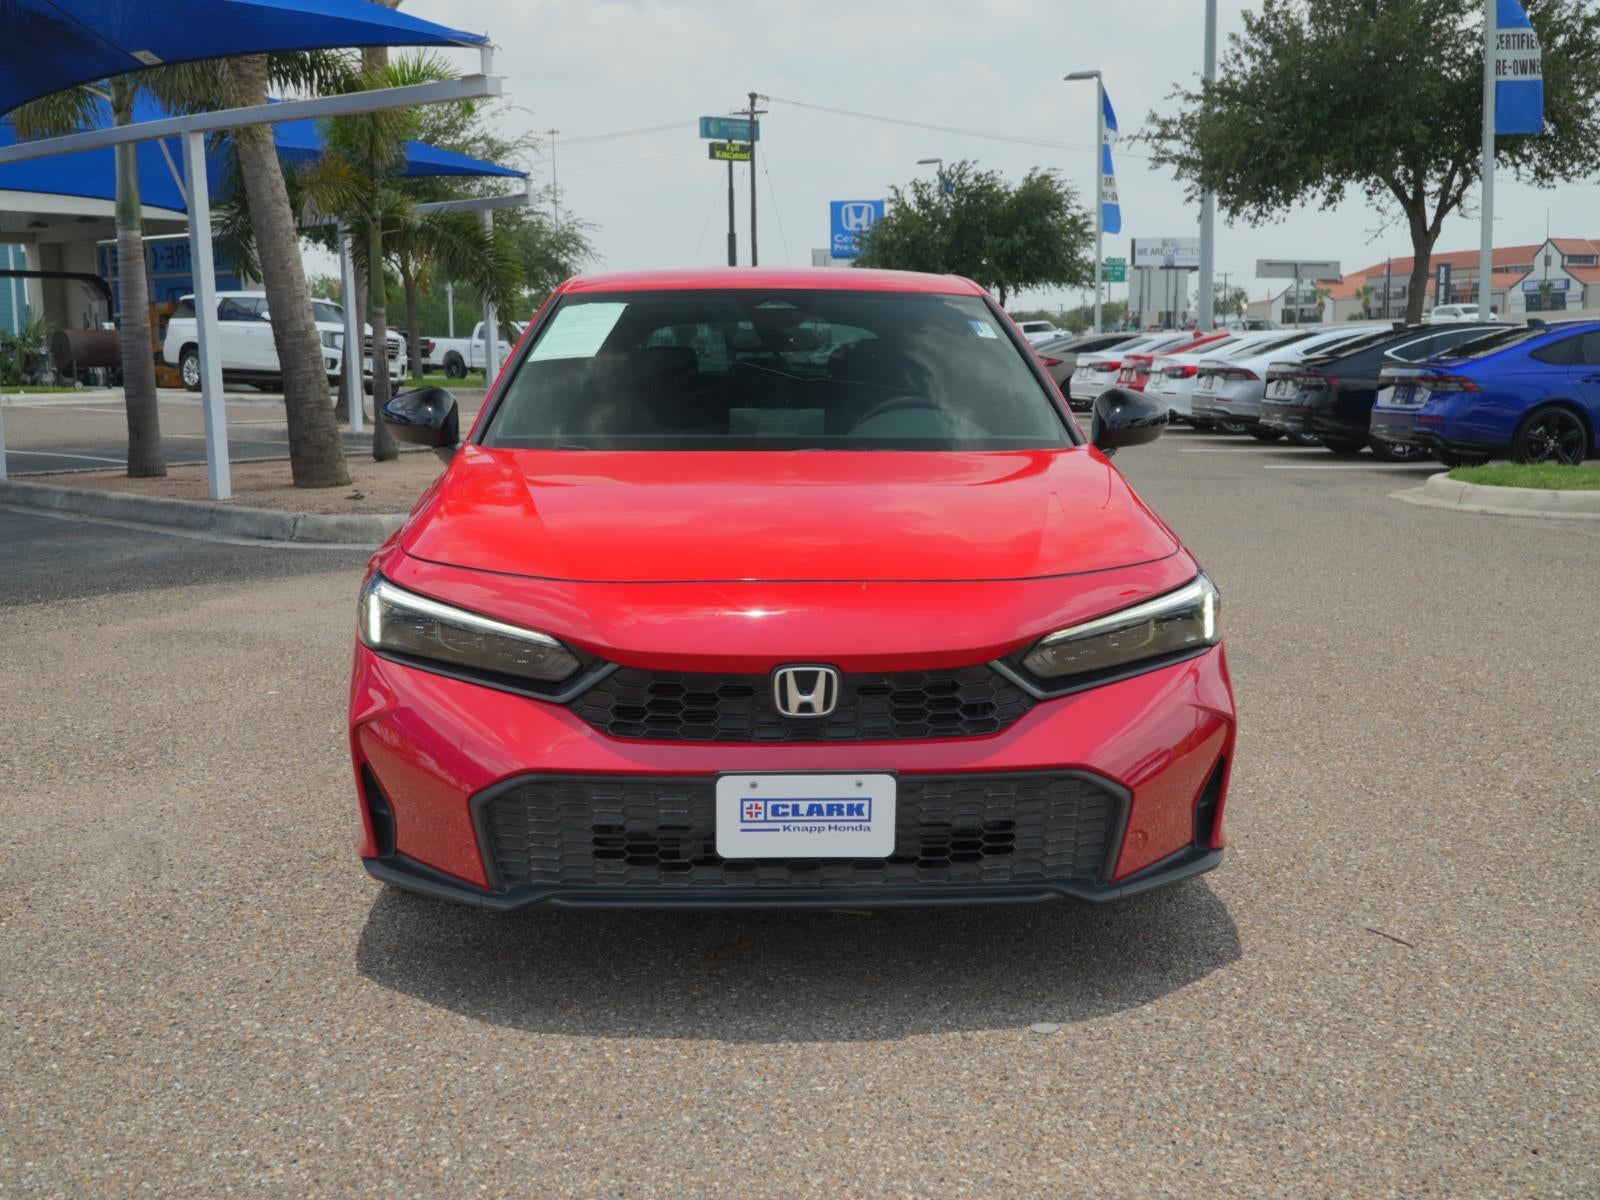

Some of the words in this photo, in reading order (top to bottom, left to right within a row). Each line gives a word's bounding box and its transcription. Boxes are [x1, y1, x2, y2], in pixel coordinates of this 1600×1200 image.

[770, 803, 865, 817] CLARK
[782, 824, 826, 834] Knapp
[828, 824, 872, 832] Honda
